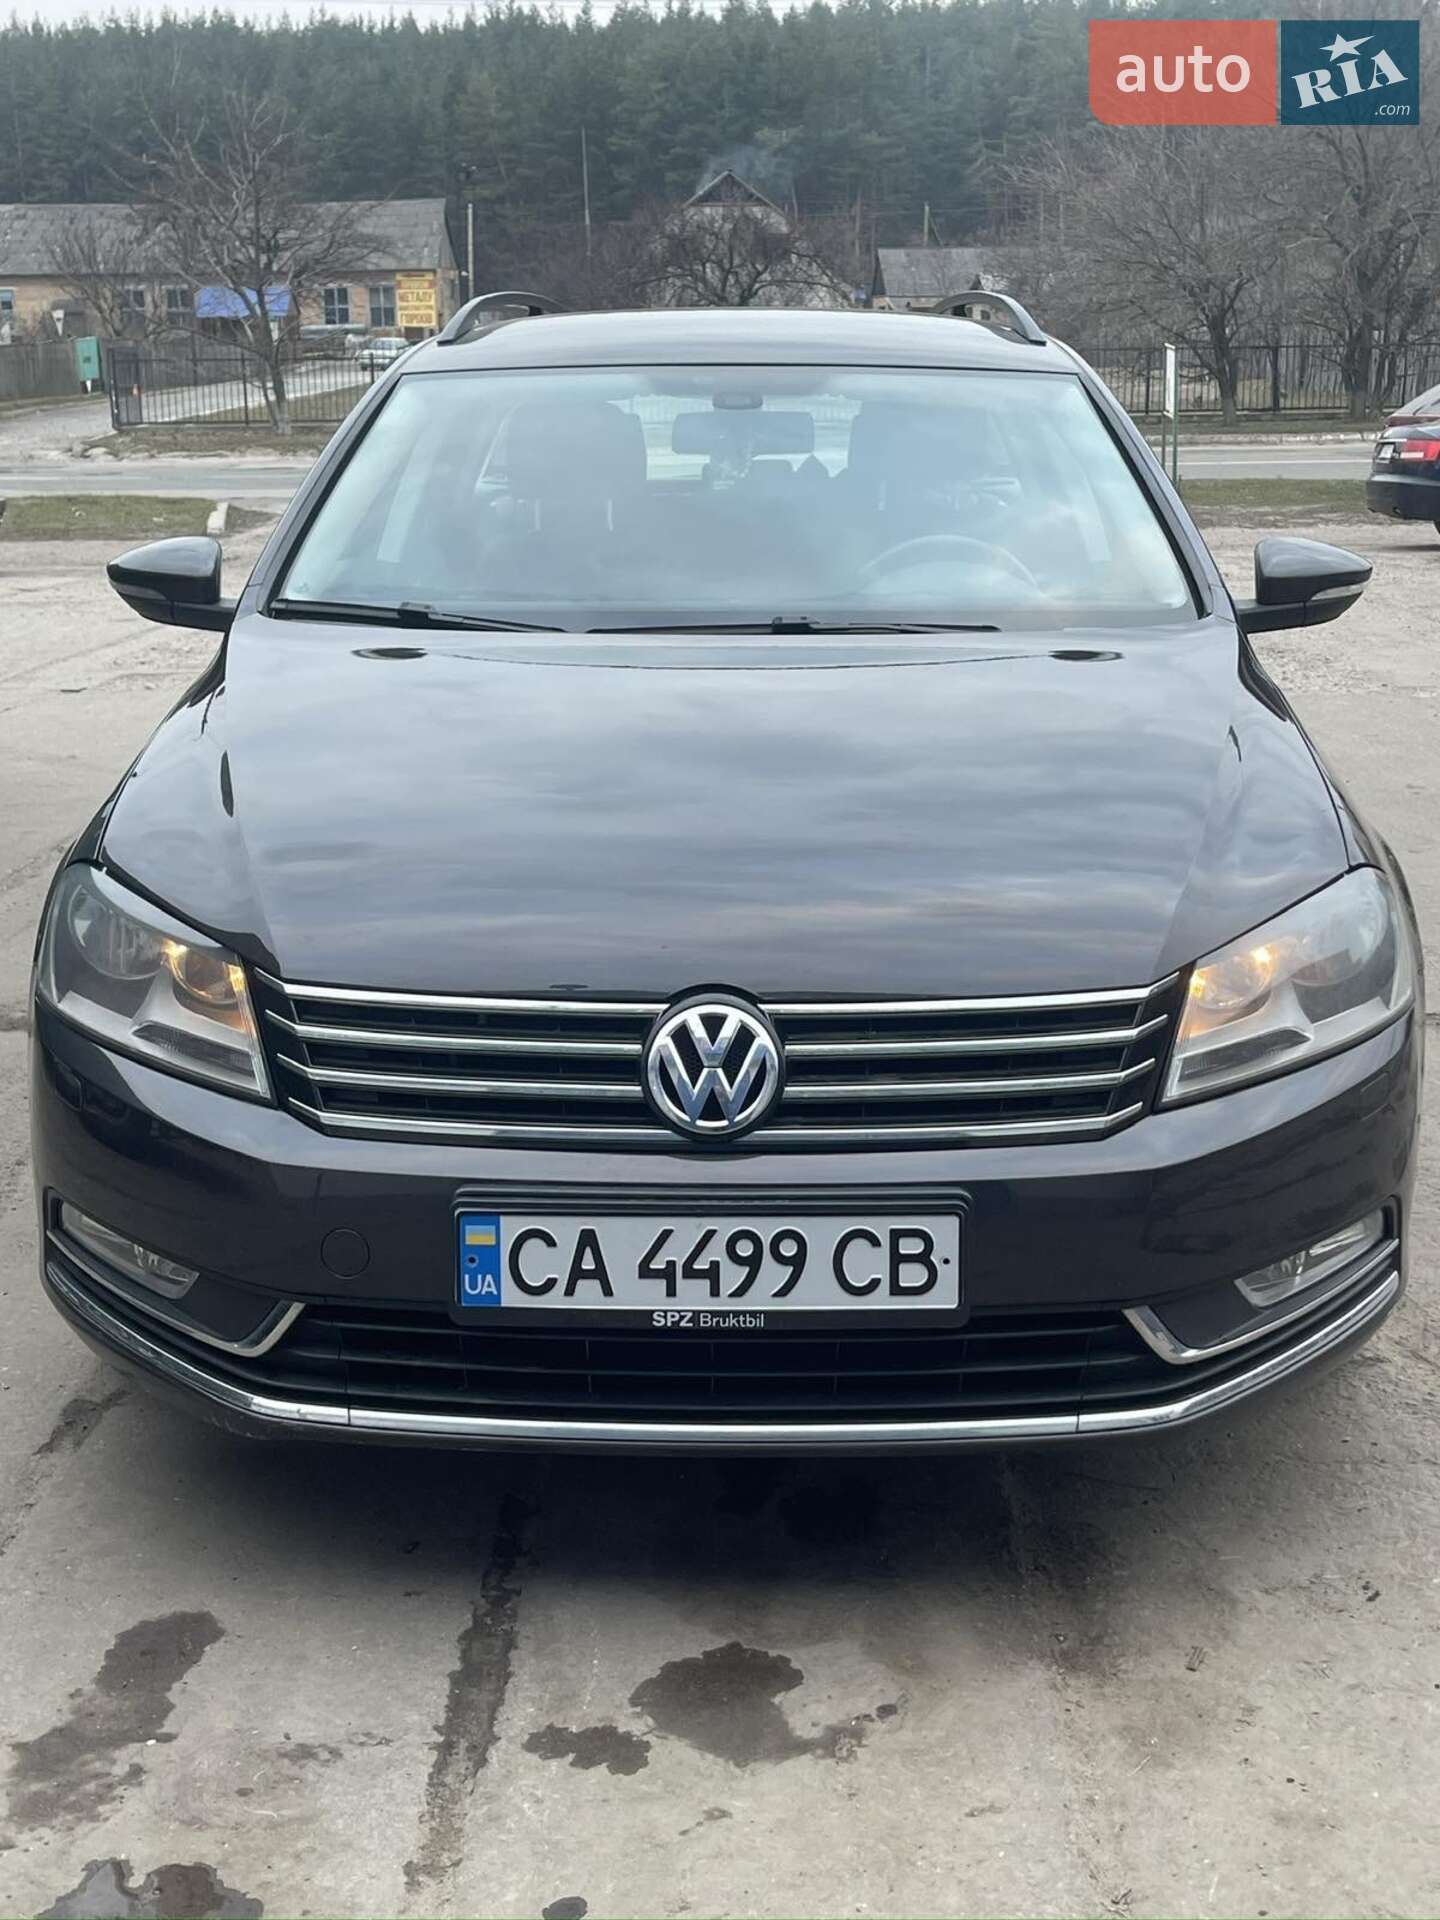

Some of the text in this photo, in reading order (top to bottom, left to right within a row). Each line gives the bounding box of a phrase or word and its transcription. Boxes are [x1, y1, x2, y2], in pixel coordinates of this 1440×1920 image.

[508, 1228, 939, 1298] CA 4499 CB
[464, 1274, 498, 1296] UA
[652, 1310, 765, 1329] SPZ Bruktbil
